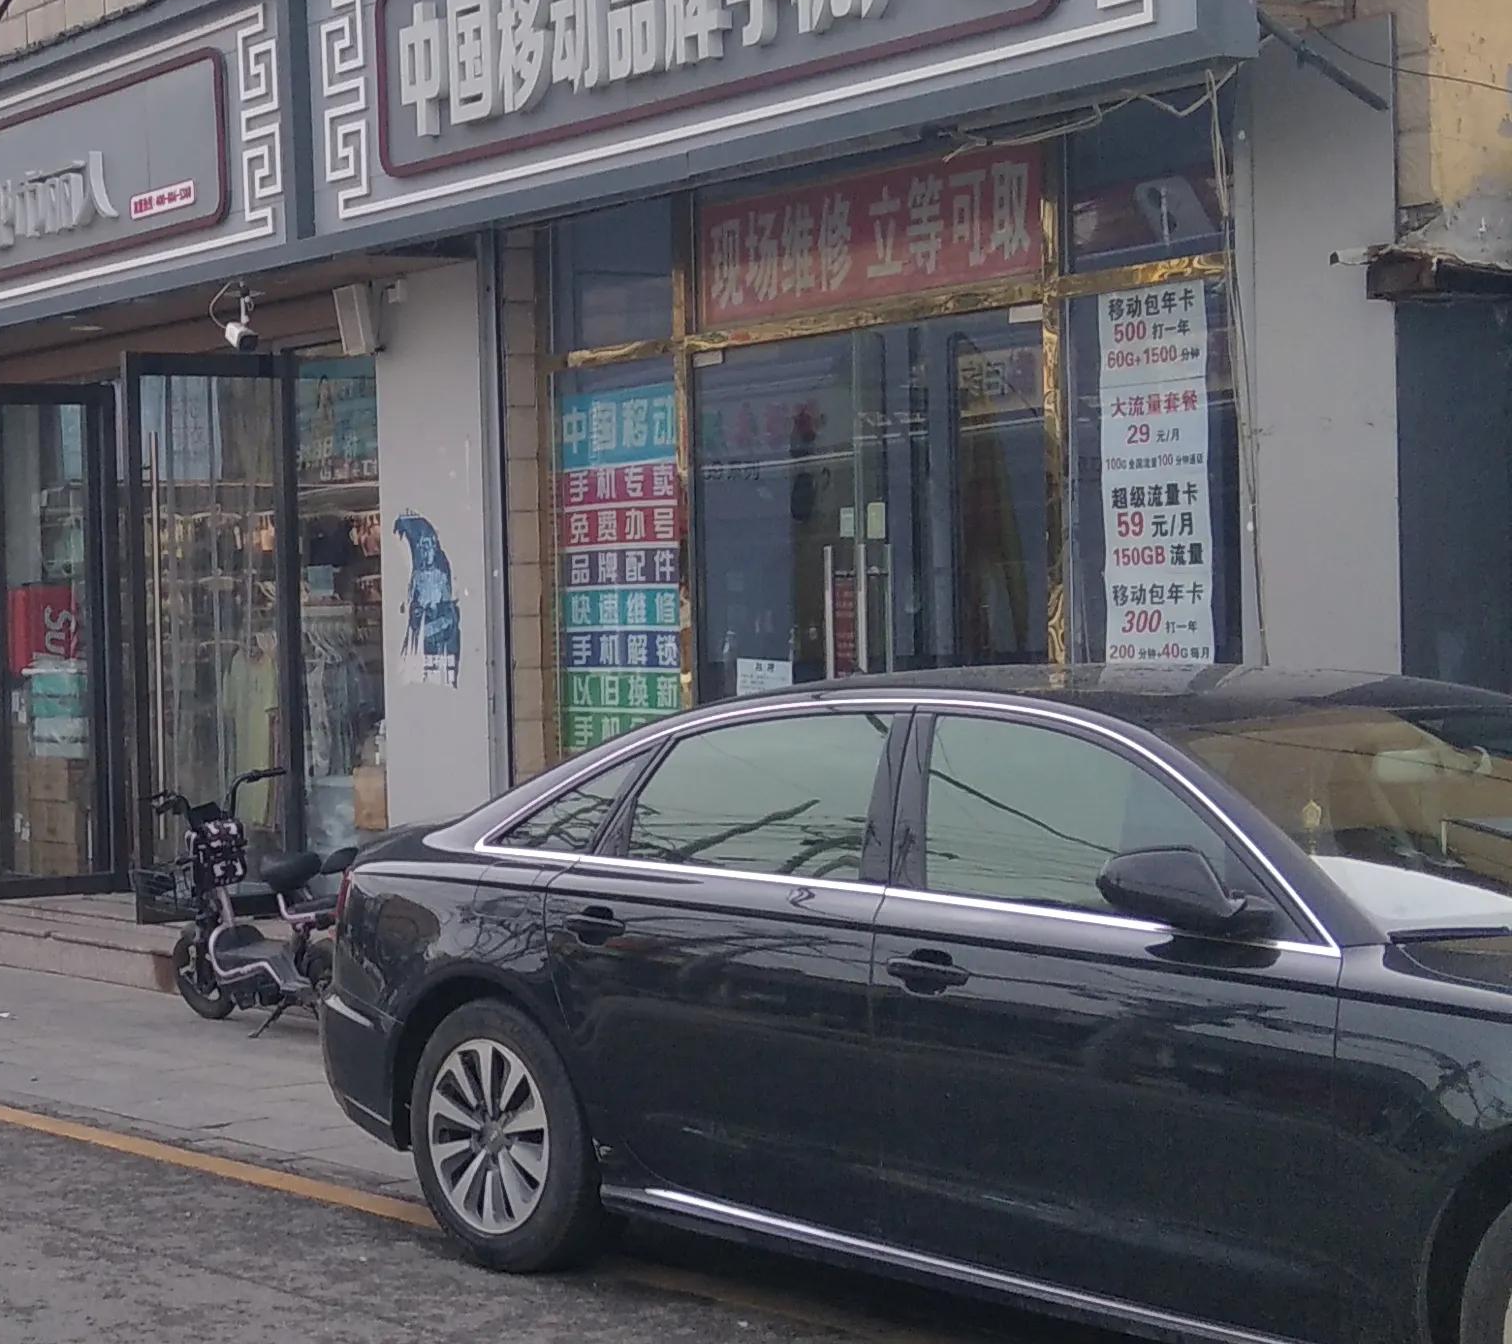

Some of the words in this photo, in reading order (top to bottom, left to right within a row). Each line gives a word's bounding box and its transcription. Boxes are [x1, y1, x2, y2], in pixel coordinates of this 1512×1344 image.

[710, 193, 853, 309] 现场维修
[867, 161, 1032, 279] 立等可取
[1108, 288, 1196, 322] 移动包年卡
[1114, 320, 1147, 343] 500
[1152, 319, 1191, 340] 打一年
[1111, 389, 1198, 418] 大流量套餐
[563, 395, 676, 454] 中国移动
[1127, 423, 1150, 444] 29
[1156, 428, 1180, 443] 元/月
[570, 465, 674, 502] 手机专卖
[1111, 482, 1198, 509] 超级流量卡
[570, 507, 675, 544] 免费办号
[1117, 511, 1144, 537] 59
[1151, 512, 1193, 537] 元/月
[571, 550, 676, 585] 品牌配件
[1113, 546, 1166, 567] 150GB
[1170, 543, 1204, 566] 流量
[572, 592, 677, 625] 快速维修
[1112, 582, 1204, 606] 移动包年卡
[1121, 609, 1162, 633] 300
[1166, 620, 1198, 634] 打一年
[572, 634, 678, 666] 手机解锁
[1109, 644, 1135, 659] 200
[573, 675, 678, 707] 以旧换新
[574, 715, 647, 754] 手机
